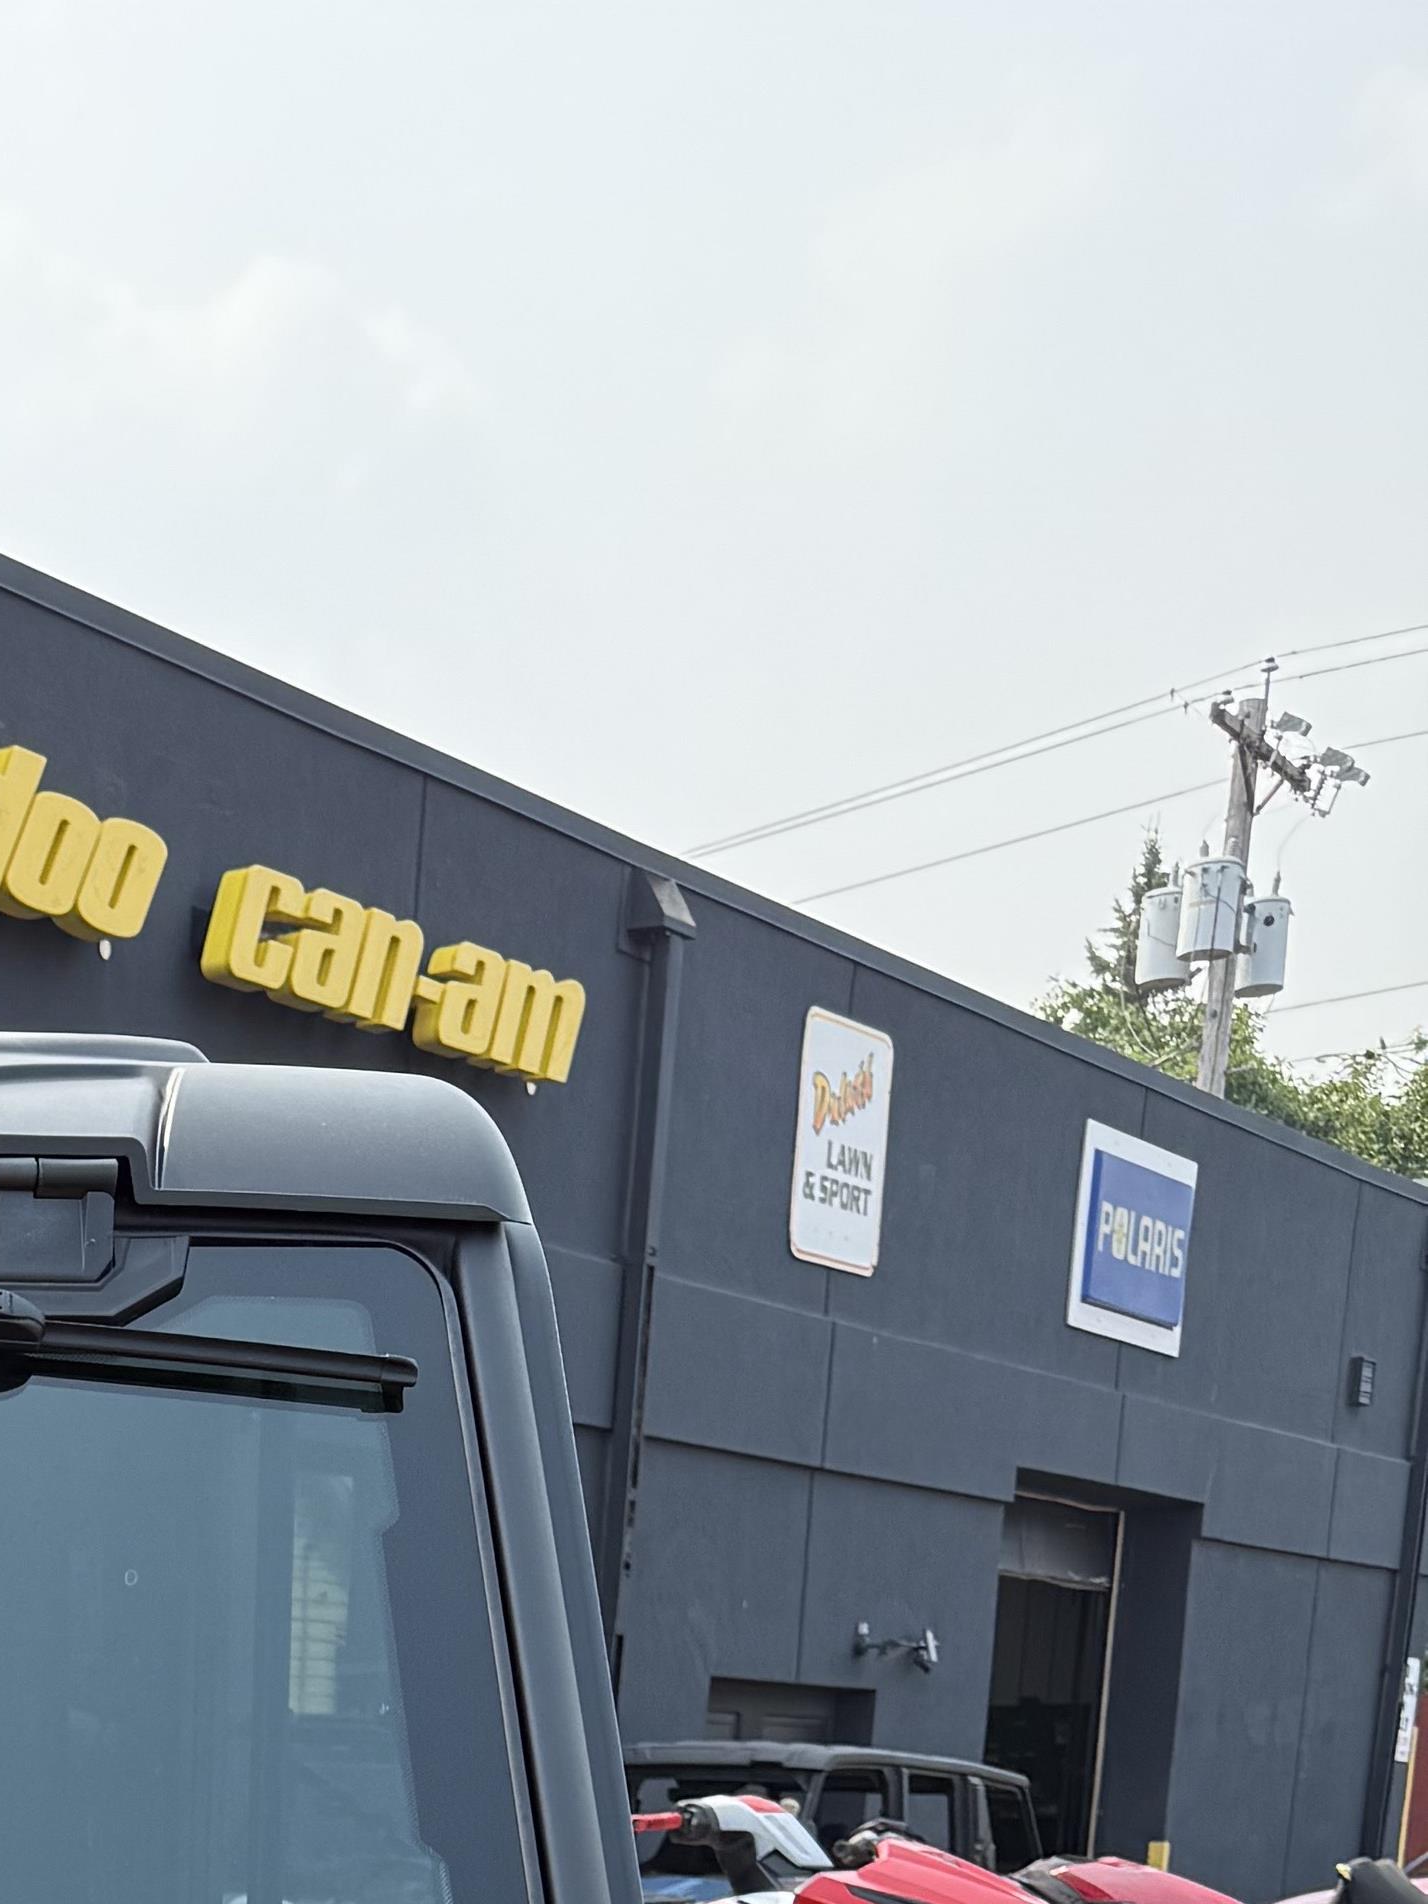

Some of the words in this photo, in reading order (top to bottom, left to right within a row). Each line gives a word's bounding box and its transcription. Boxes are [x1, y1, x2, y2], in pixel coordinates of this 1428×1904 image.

[200, 864, 586, 1083] can-am
[826, 1139, 874, 1182] LAWN
[802, 1169, 816, 1202] &
[818, 1175, 872, 1217] SPORT
[1097, 1200, 1186, 1279] POLARIS
